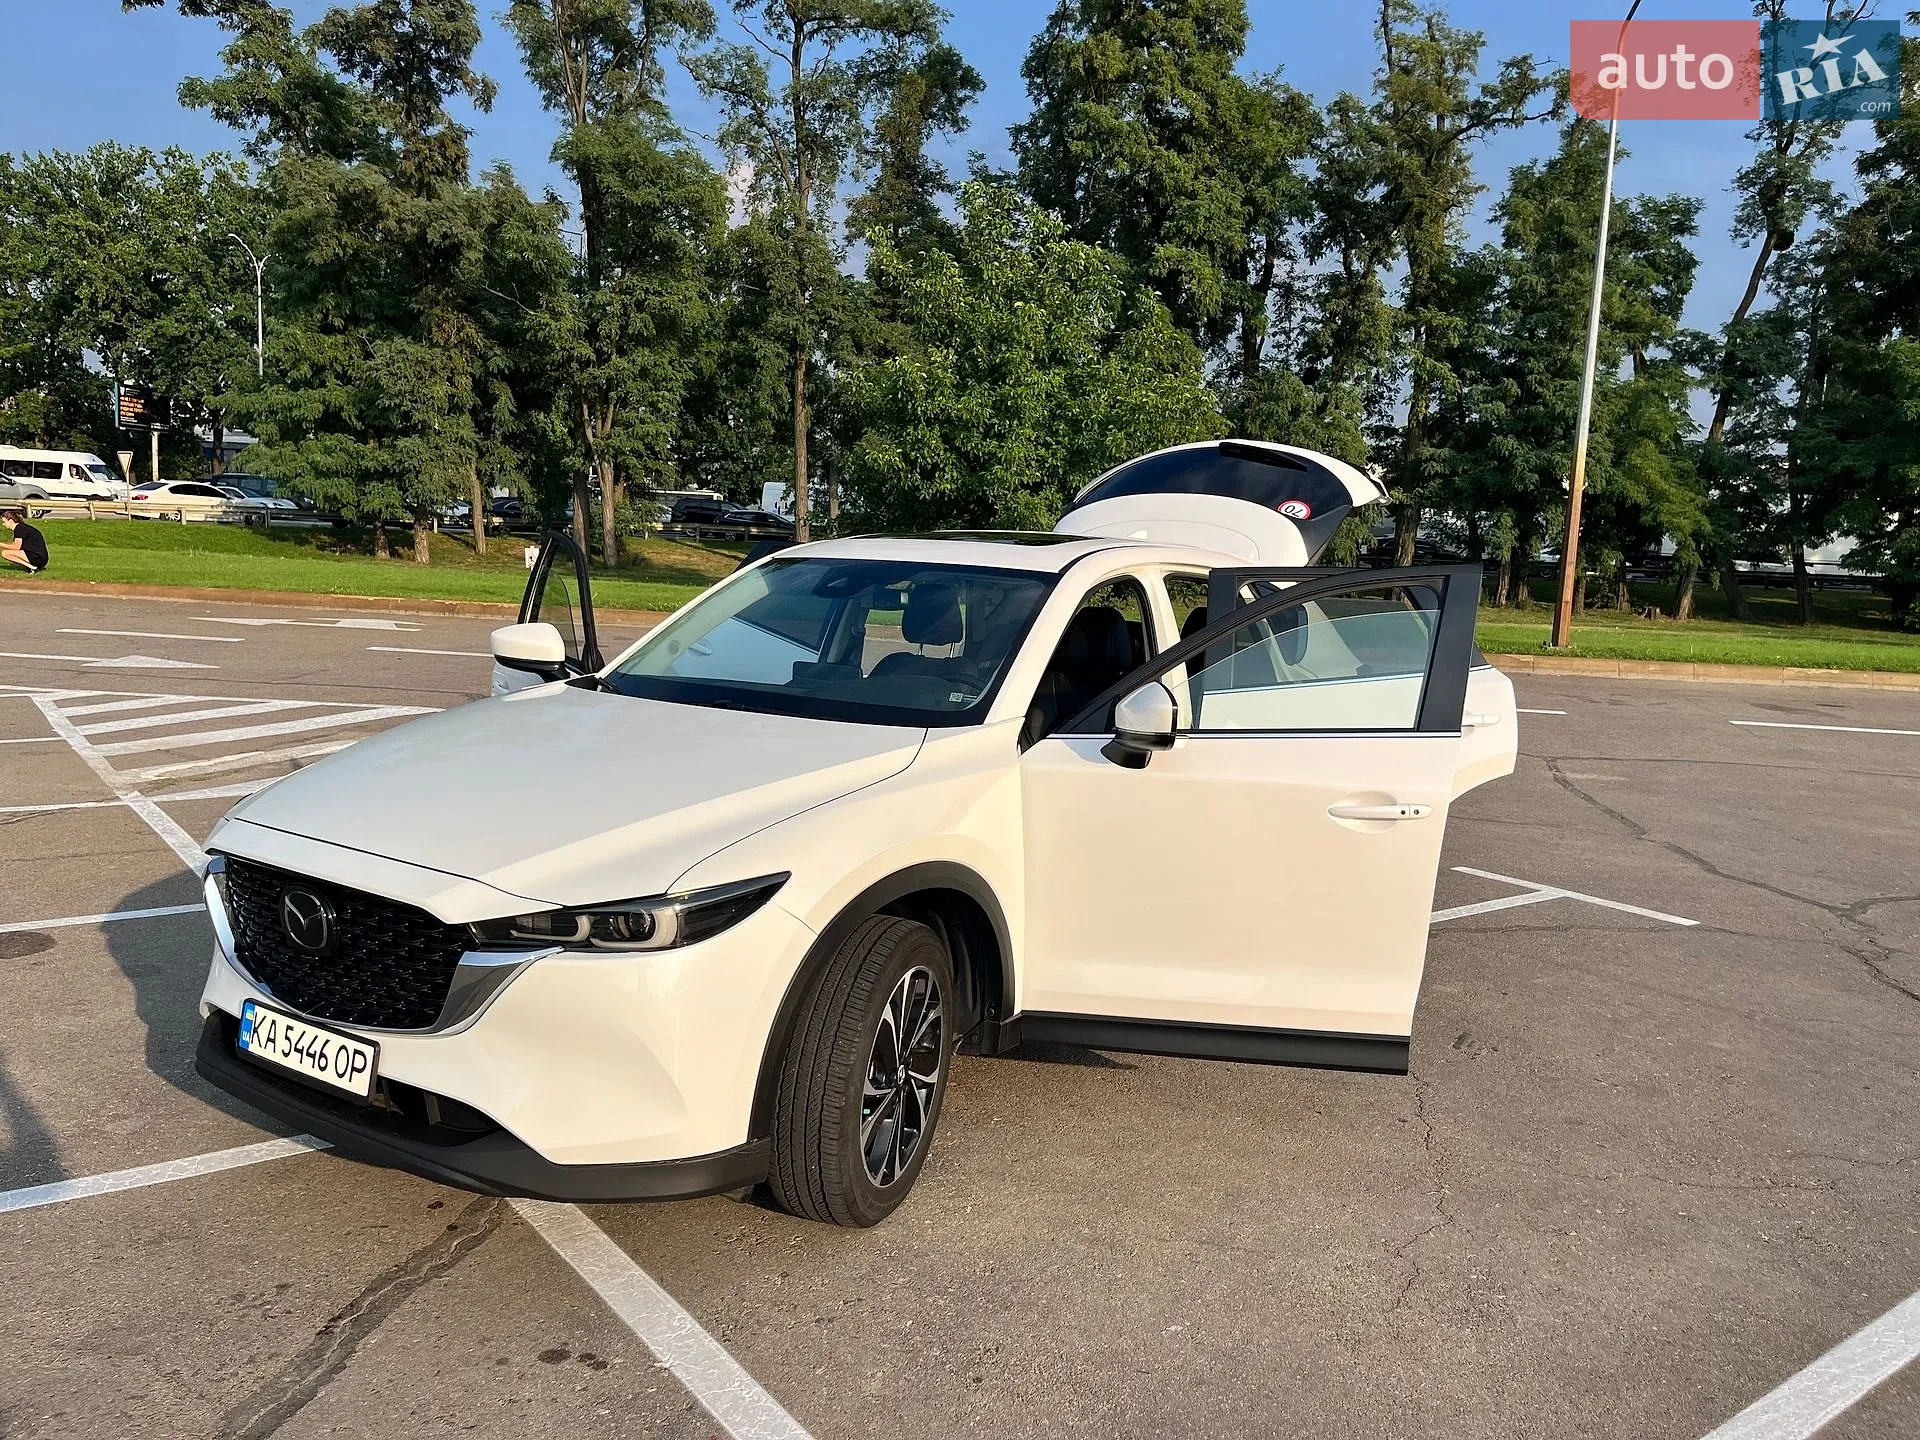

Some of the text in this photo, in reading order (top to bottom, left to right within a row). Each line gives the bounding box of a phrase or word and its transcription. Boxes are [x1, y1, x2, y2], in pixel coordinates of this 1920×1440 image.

[1284, 504, 1304, 518] 70
[242, 1031, 251, 1043] UA
[250, 1011, 368, 1083] KA 5446 OP
